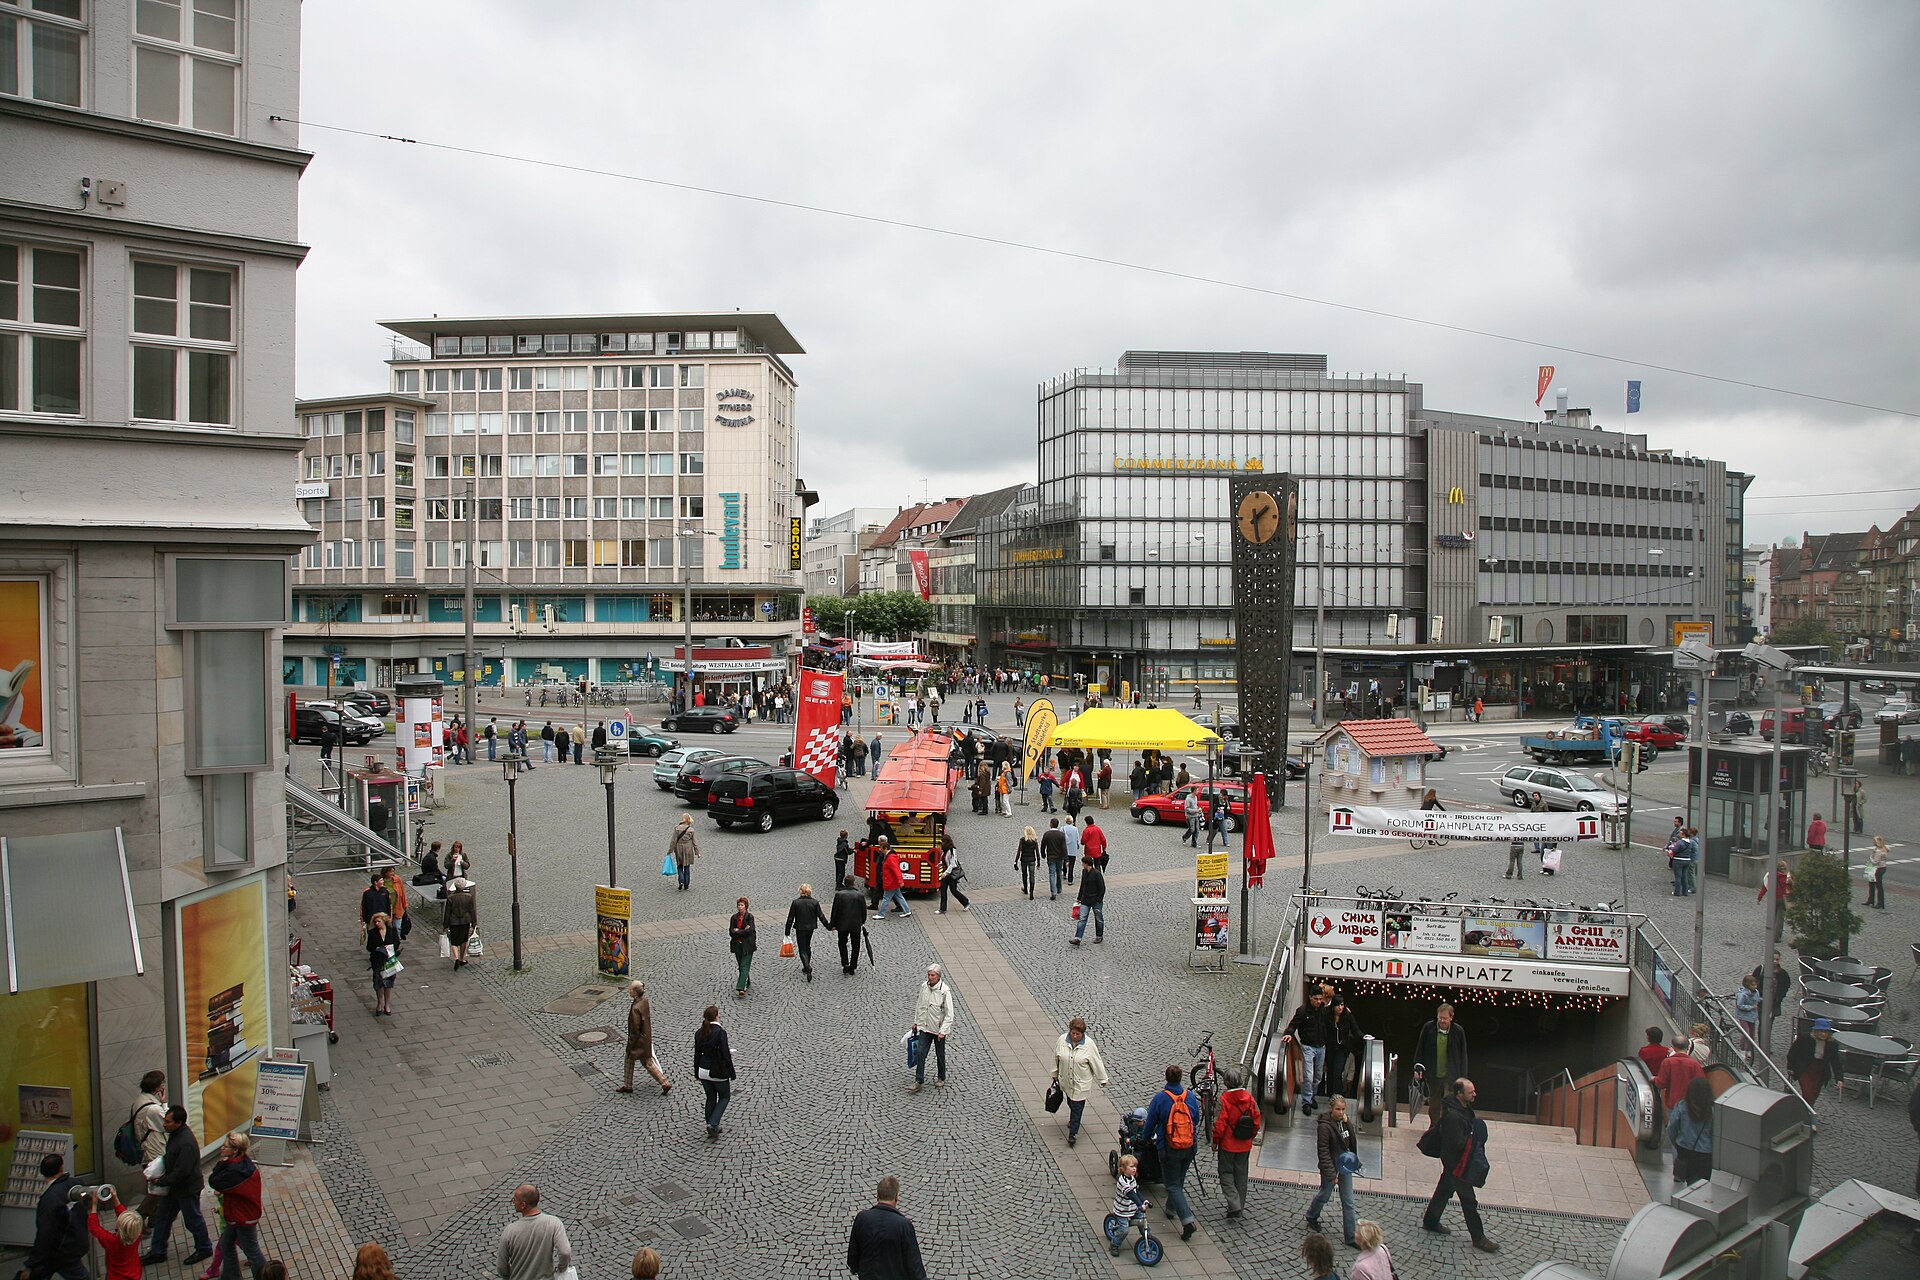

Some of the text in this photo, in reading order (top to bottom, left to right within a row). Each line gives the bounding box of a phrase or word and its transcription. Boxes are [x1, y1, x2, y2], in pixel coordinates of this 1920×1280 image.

[716, 388, 754, 401] DAMEN
[718, 404, 752, 412] FITNESS
[715, 414, 755, 428] FEMINA
[1114, 458, 1238, 470] COMMERZBANK
[296, 488, 324, 496] Sports
[719, 492, 740, 570] boulevard
[444, 598, 482, 608] boulrd
[805, 696, 835, 704] SEAT
[1031, 712, 1048, 744] Stadtwerke
[1037, 722, 1050, 746] Bielefeld
[366, 756, 374, 767] T
[1387, 819, 1547, 832] FORUM JAHNPLATZ PASSAGE
[1392, 830, 1438, 839] GESCHÄFTE
[1341, 912, 1376, 924] CHINA
[1338, 925, 1379, 936] IMBISS
[1571, 926, 1603, 936] Grill
[1554, 936, 1619, 948] ANTALYA
[1321, 956, 1513, 983] FORUM JAHNPLATZ
